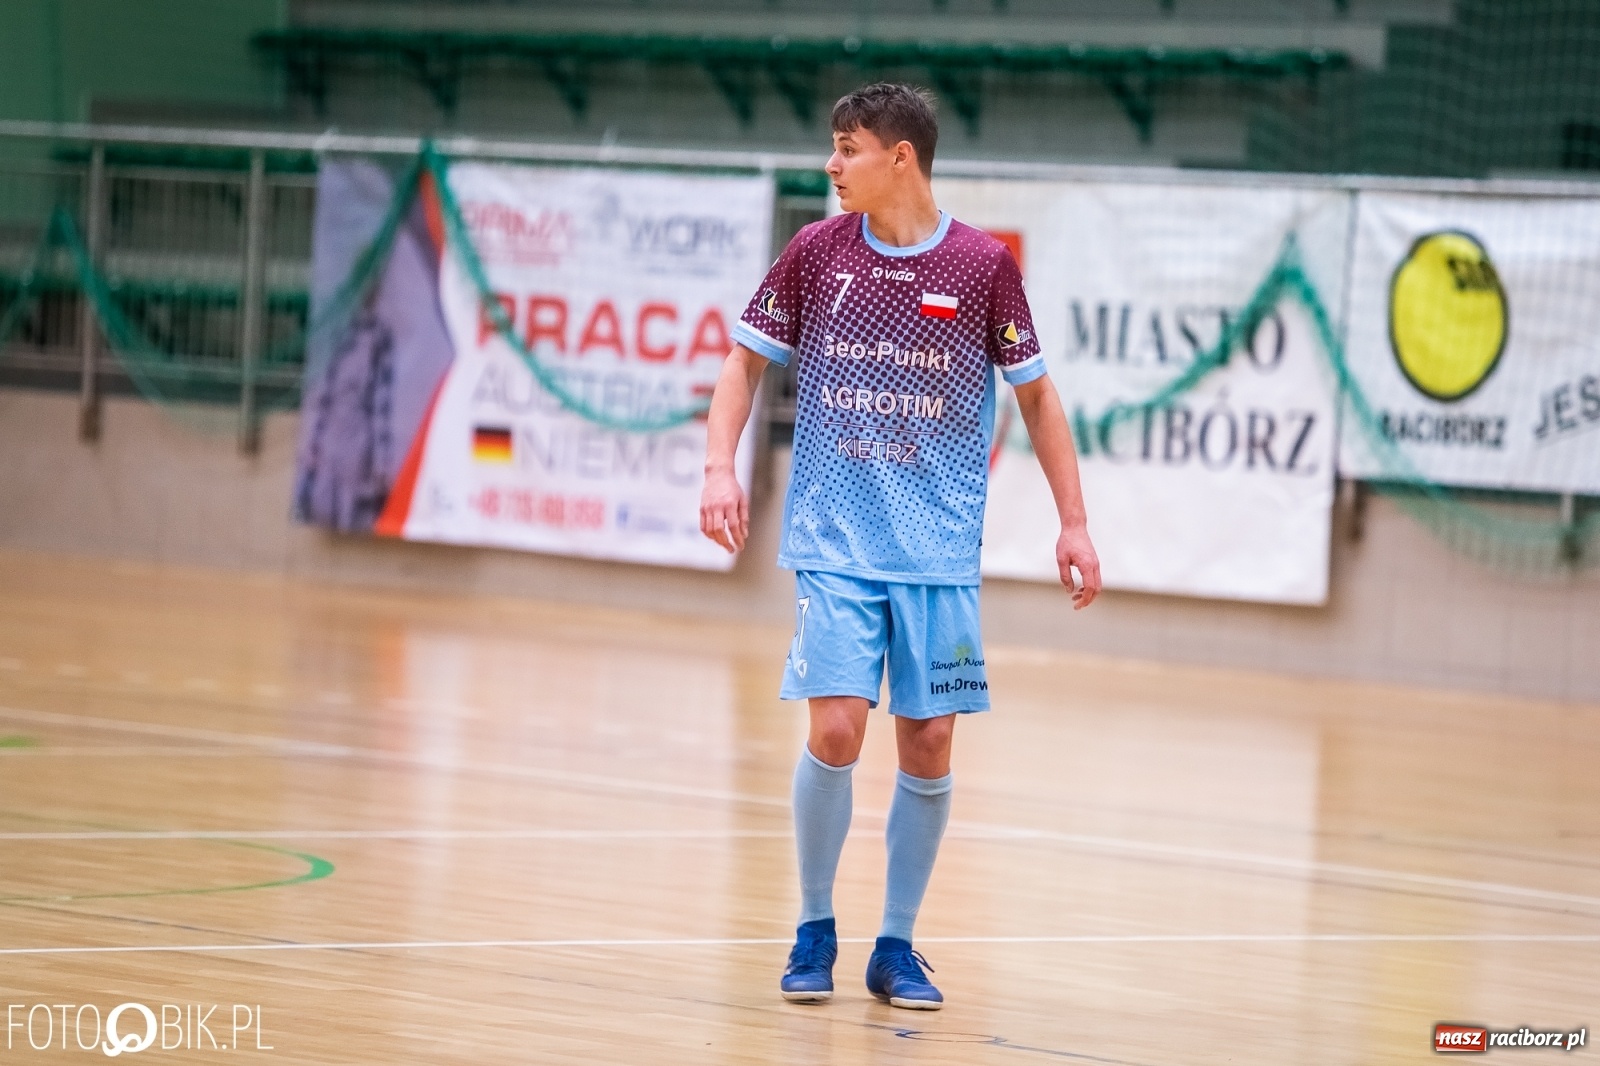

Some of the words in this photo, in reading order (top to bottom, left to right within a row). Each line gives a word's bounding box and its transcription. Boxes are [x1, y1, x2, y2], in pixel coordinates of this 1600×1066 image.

[831, 272, 856, 314] 7
[477, 293, 737, 366] PRACA
[824, 334, 952, 372] Geo-Punkt
[1065, 297, 1287, 376] MIASTO
[821, 385, 944, 420] AGROTIM
[522, 425, 704, 488] NIEMC
[837, 437, 918, 464] KIETRZ
[1072, 384, 1320, 477] ACIBÓRZ
